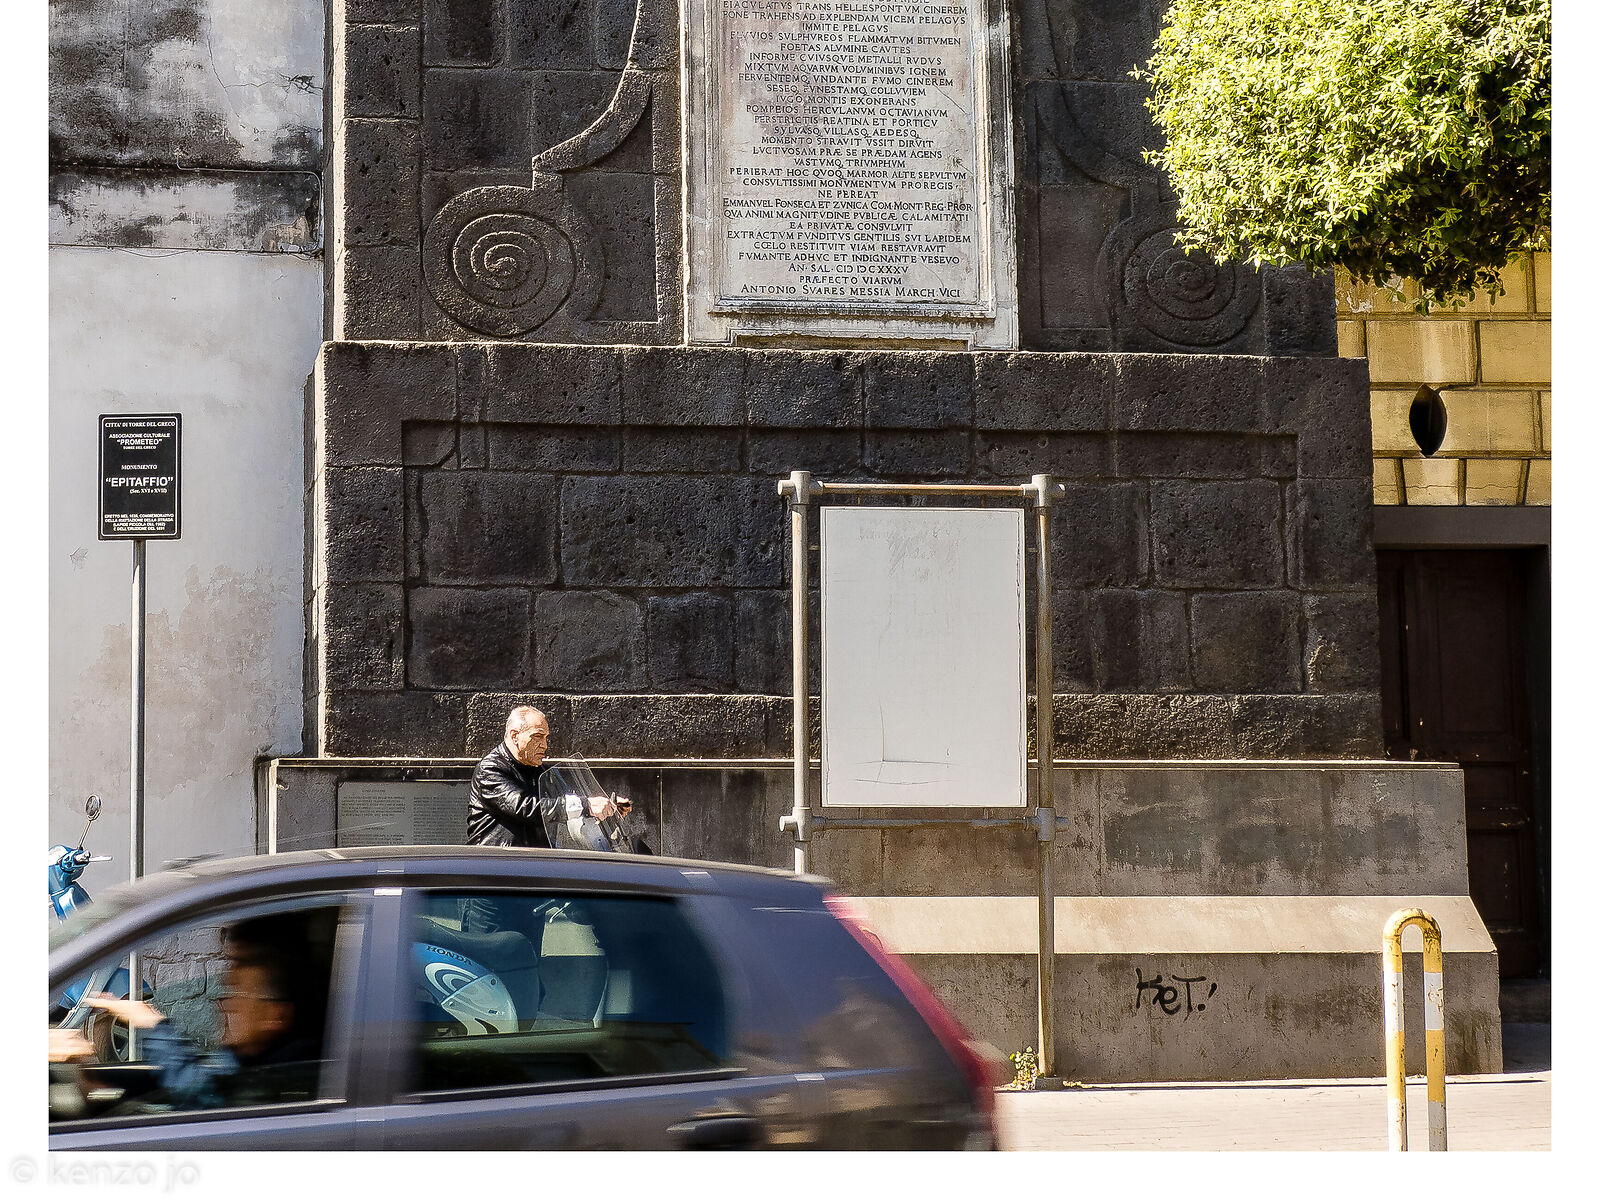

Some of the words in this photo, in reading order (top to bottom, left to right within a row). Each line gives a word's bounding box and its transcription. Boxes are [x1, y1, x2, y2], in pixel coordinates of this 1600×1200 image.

[796, 2, 832, 11] TRANS
[836, 3, 920, 14] HELLESPONTVM
[924, 6, 968, 15] CINEREM
[752, 11, 800, 21] TRAHENS
[802, 12, 816, 21] AD
[820, 13, 880, 23] EXPLENDAM
[882, 15, 916, 24] VICEM
[918, 16, 966, 25] PELAGVS
[802, 22, 840, 32] IMMITE
[842, 24, 889, 33] PELAGVS
[778, 32, 843, 42] SVLPHVREOS
[848, 34, 914, 44] FLAMMATVM
[917, 36, 961, 46] BITVMEN
[780, 43, 821, 52] FOETAS
[824, 44, 868, 53] ALVMINE
[871, 46, 911, 54] CAVTES
[858, 55, 902, 64] METALLI
[906, 57, 942, 66] RVDVS
[744, 62, 790, 72] MIXTVM
[909, 67, 947, 76] IGNEM
[872, 76, 902, 84] FVMO
[906, 77, 954, 86] CINEREM
[808, 96, 847, 104] MONTIS
[850, 96, 916, 106] EXONERANS
[746, 104, 799, 114] POMPEIOS
[804, 106, 876, 116] HERCVLANVM
[880, 108, 948, 118] OCTAVIANVM
[872, 117, 888, 126] ET
[892, 119, 938, 128] PORTICV
[761, 136, 813, 145] MOMENTO
[816, 137, 862, 146] STRAVIT
[866, 139, 895, 147] VSSIT
[898, 140, 934, 148] DIRVIT
[752, 146, 817, 156] LVCTVOSAM
[846, 148, 858, 157] SE
[910, 150, 943, 159] AGENS
[846, 159, 906, 168] TRIVMPHVM
[730, 167, 783, 176] PERIERAT
[786, 168, 810, 177] HOC
[846, 170, 889, 178] MARMOR
[892, 171, 916, 179] ALTE
[918, 171, 967, 180] SEPVLTVM
[742, 178, 817, 187] CONSVLTISSIMI
[820, 179, 897, 189] MONVMENTVM
[818, 190, 833, 198] NE
[837, 190, 879, 199] PEREAT
[722, 198, 774, 208] EMMANVEL
[775, 198, 817, 209] FONSECA
[818, 201, 830, 209] ET
[724, 210, 743, 220] QVA
[744, 210, 774, 218] ANIMI
[776, 211, 850, 220] MAGNITVDINE
[902, 213, 969, 222] CALAMITATI
[790, 222, 803, 230] EA
[727, 230, 794, 240] EXTRACTVM
[798, 232, 850, 241] FVNDITVS
[854, 233, 901, 242] GENTILIS
[904, 234, 921, 242] SVI
[925, 234, 972, 243] LAPIDEM
[790, 242, 846, 251] RESTITVIT
[850, 243, 876, 252] VIAM
[881, 244, 946, 253] RESTAVRAVIT
[738, 252, 791, 261] FVMANTE
[794, 253, 830, 262] ADHVC
[834, 253, 848, 262] ET
[852, 254, 917, 264] INDIGNANTE
[920, 255, 960, 264] VESEVO
[862, 276, 902, 285] VIARVM
[740, 284, 796, 294] ANTONIO
[802, 284, 846, 296] SVARES
[850, 287, 891, 296] MESSIA
[939, 288, 961, 298] VICI
[427, 946, 472, 966] HONDA
